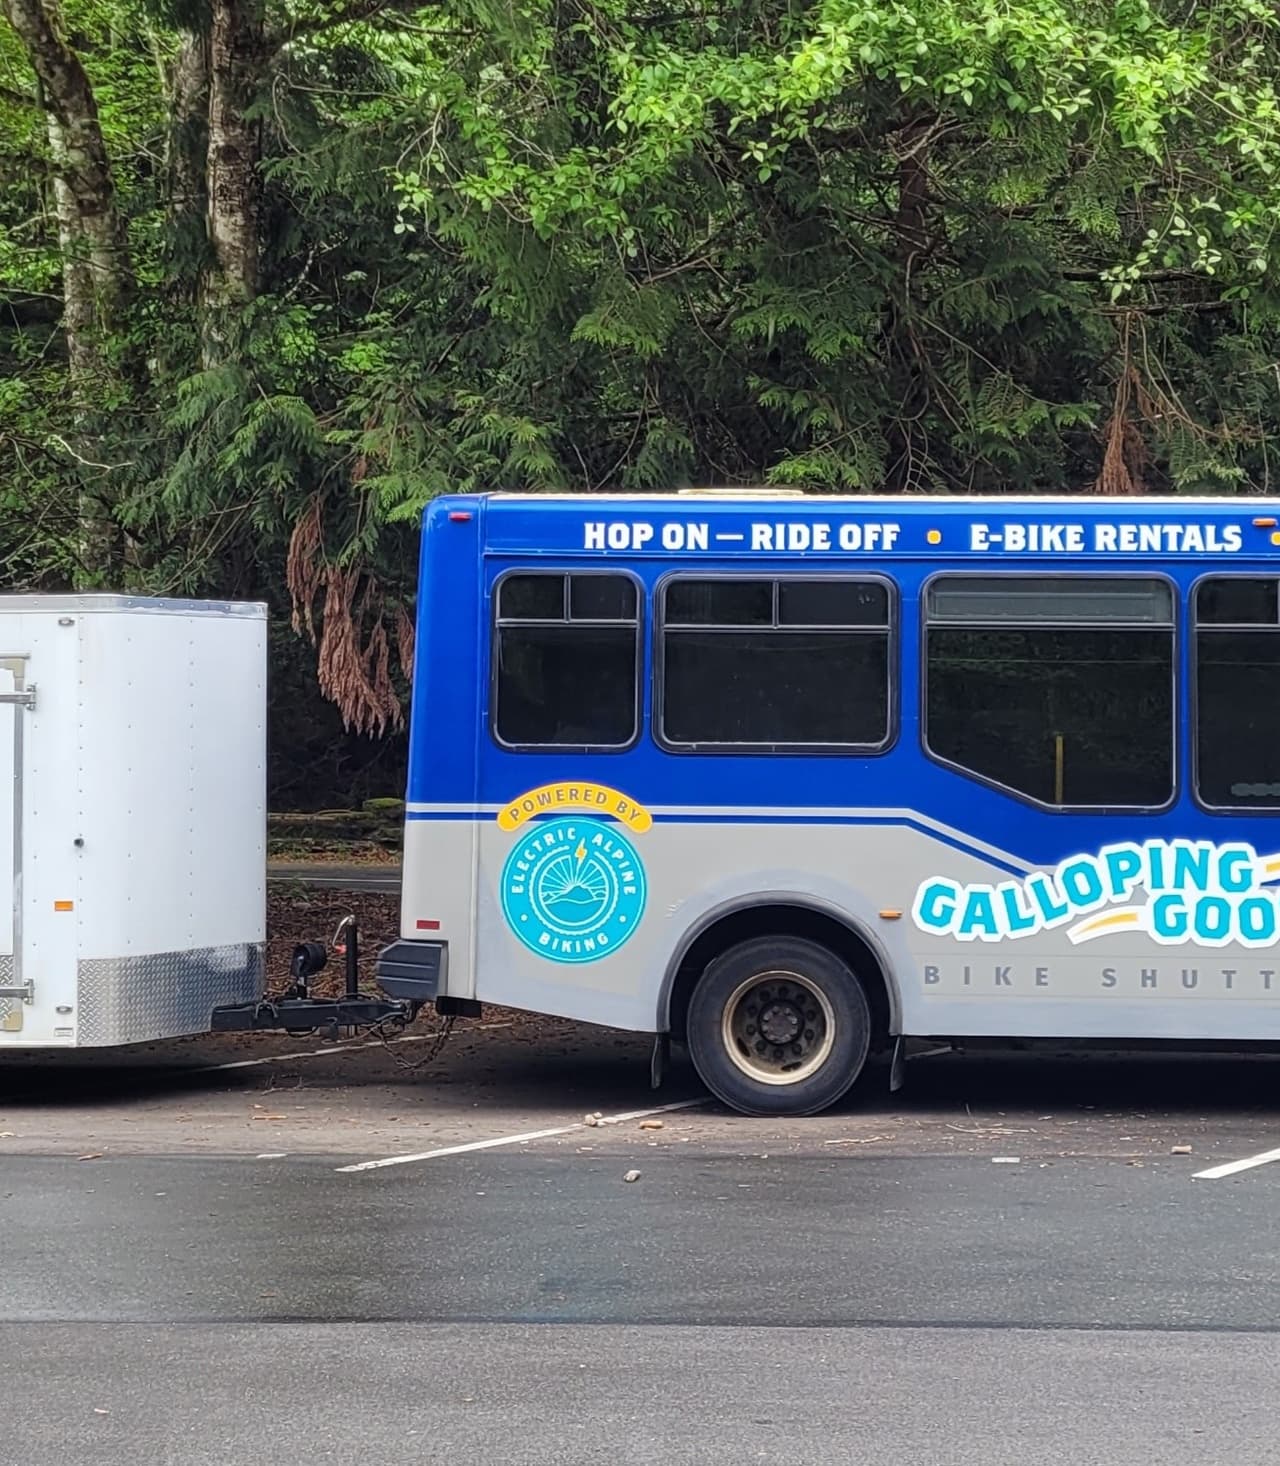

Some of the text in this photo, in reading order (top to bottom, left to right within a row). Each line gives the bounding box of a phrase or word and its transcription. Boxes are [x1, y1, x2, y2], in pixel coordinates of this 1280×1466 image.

[584, 522, 654, 550] HOP
[662, 523, 709, 550] ON
[751, 523, 831, 551] RIDE
[839, 523, 901, 551] OFF
[970, 524, 1243, 552] E-BIKE RENTALS
[509, 788, 641, 822] POWERED BY
[511, 827, 637, 895] ELECTRIC ALPINE
[918, 845, 1255, 936] GALLOPING
[538, 932, 609, 953] BIKING
[924, 966, 1049, 987] BIKE
